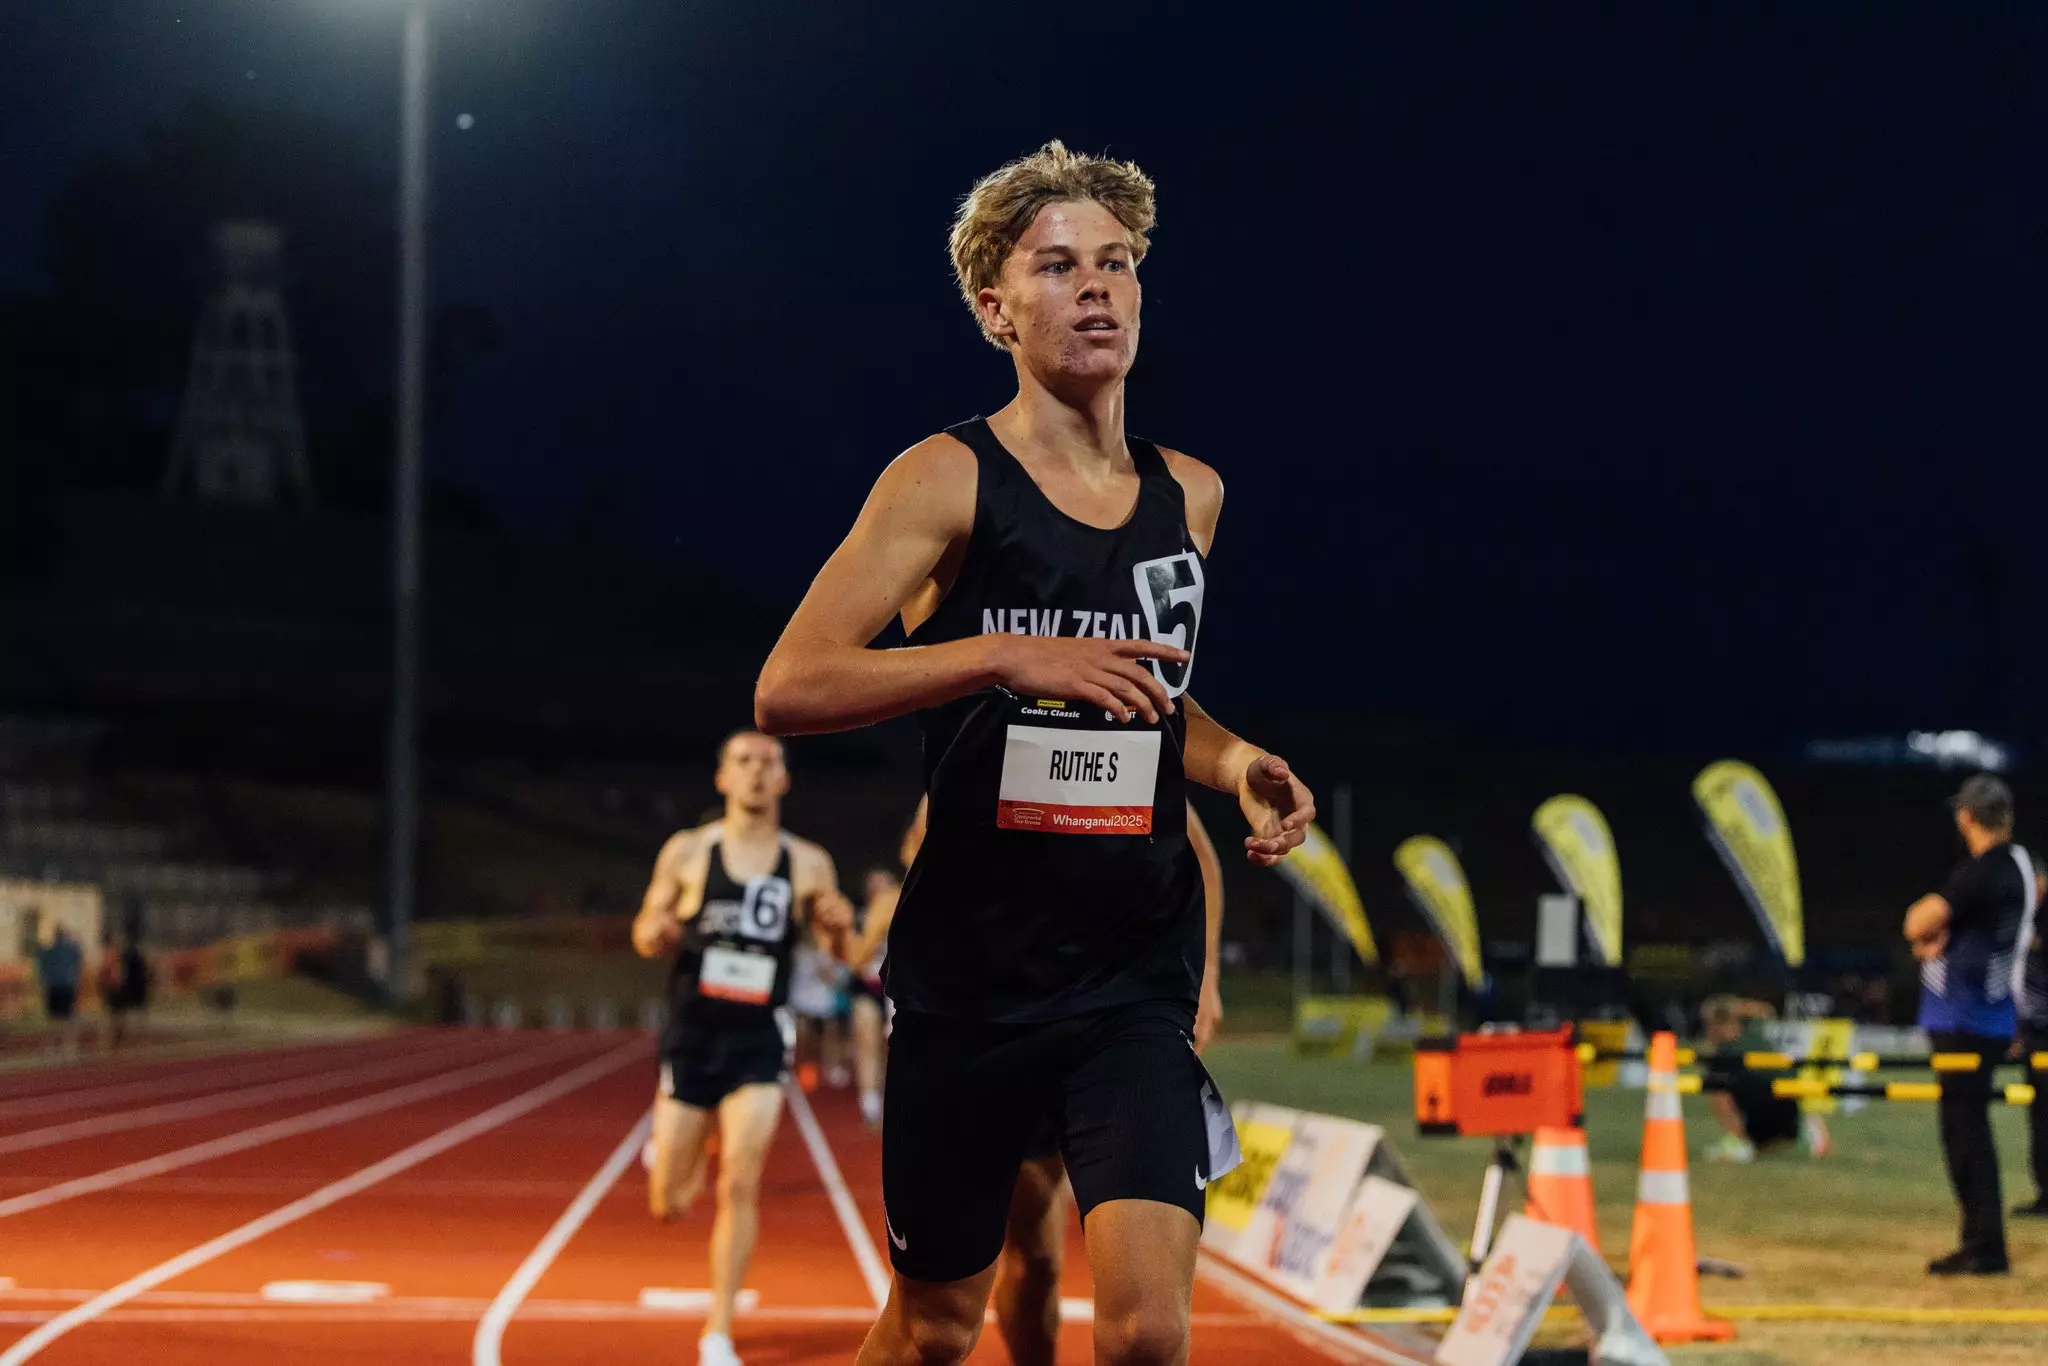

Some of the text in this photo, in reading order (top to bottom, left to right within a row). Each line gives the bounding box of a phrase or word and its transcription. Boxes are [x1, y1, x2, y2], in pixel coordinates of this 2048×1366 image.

[982, 608, 1145, 655] NEW ZEAL
[1145, 558, 1197, 689] 5
[1021, 707, 1080, 718] Cooks Classic
[1049, 750, 1119, 782] RUTHE S
[1014, 813, 1042, 821] Continental
[1052, 813, 1144, 829] Whanganui2025
[752, 881, 779, 930] 6
